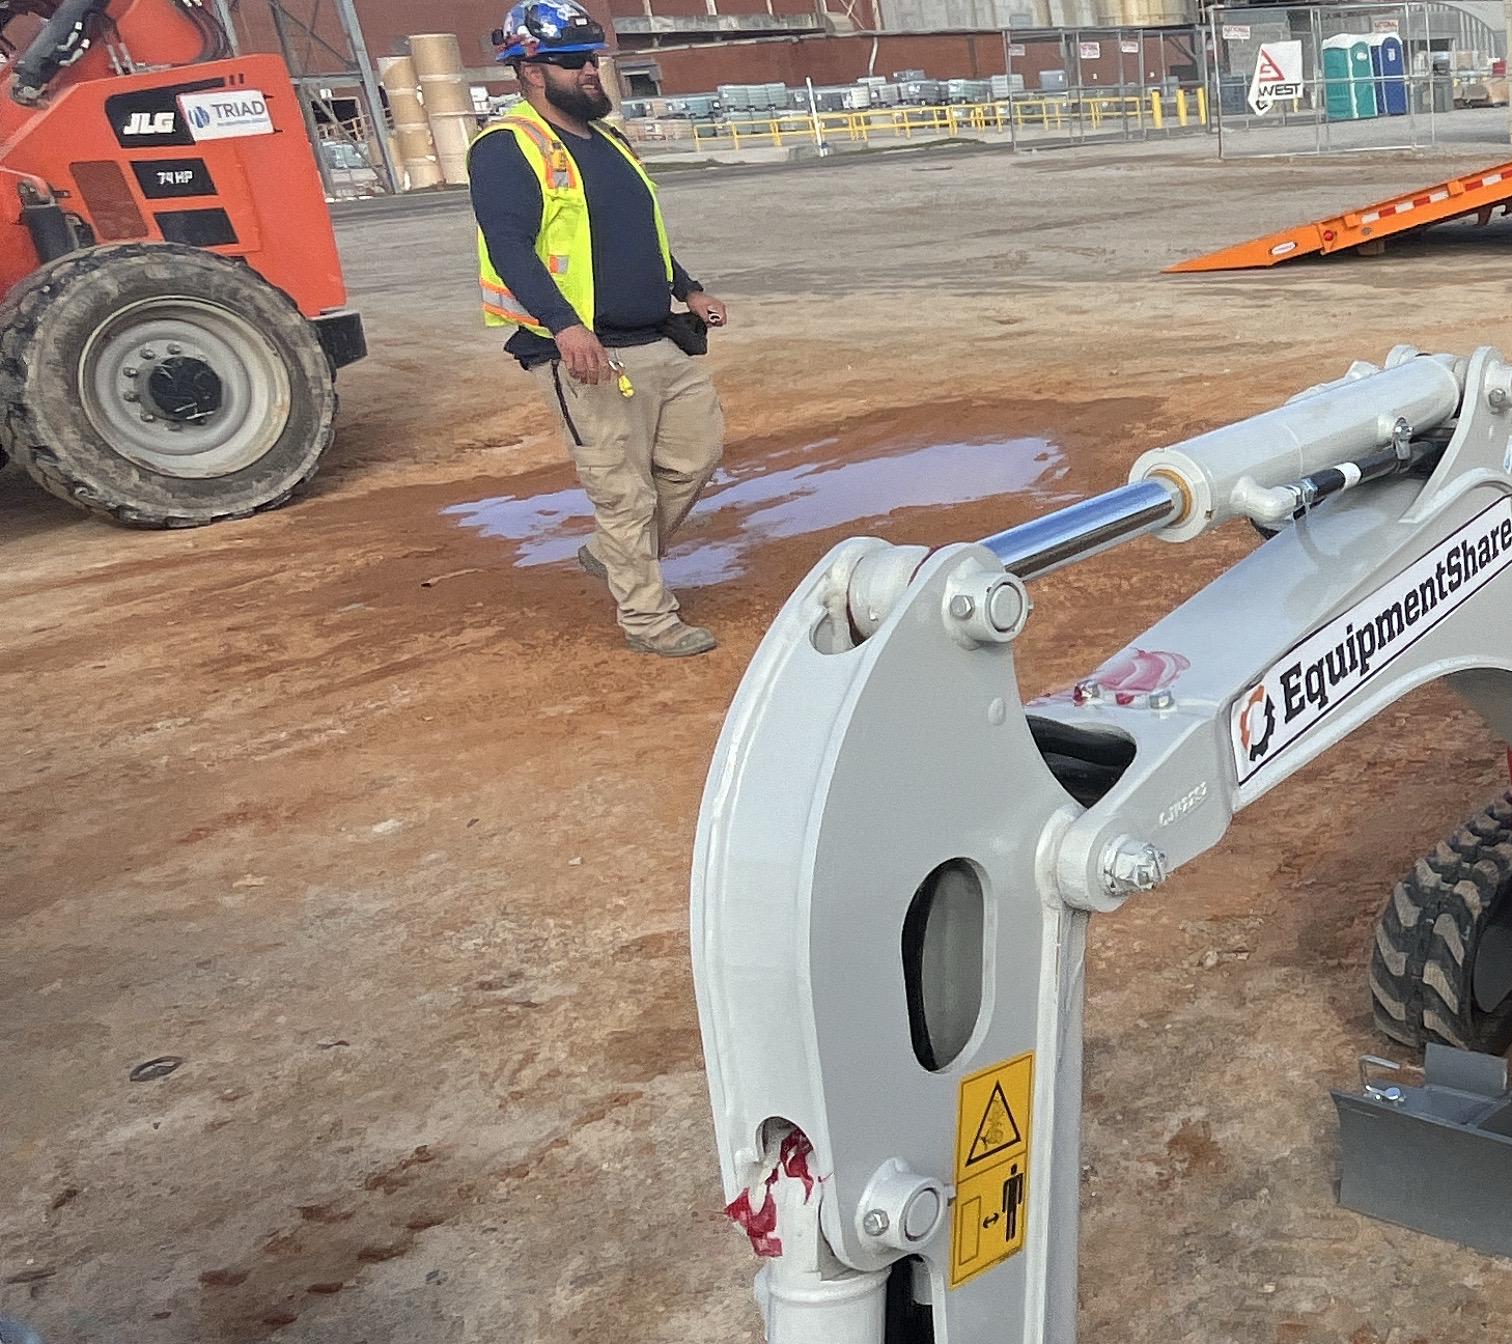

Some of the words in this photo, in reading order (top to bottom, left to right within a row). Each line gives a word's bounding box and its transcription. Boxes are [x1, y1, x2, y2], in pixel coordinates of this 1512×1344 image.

[211, 100, 265, 119] TRIAD
[122, 112, 177, 135] JLG
[175, 170, 193, 184] HP
[1279, 517, 1512, 725] EquipmentShare
